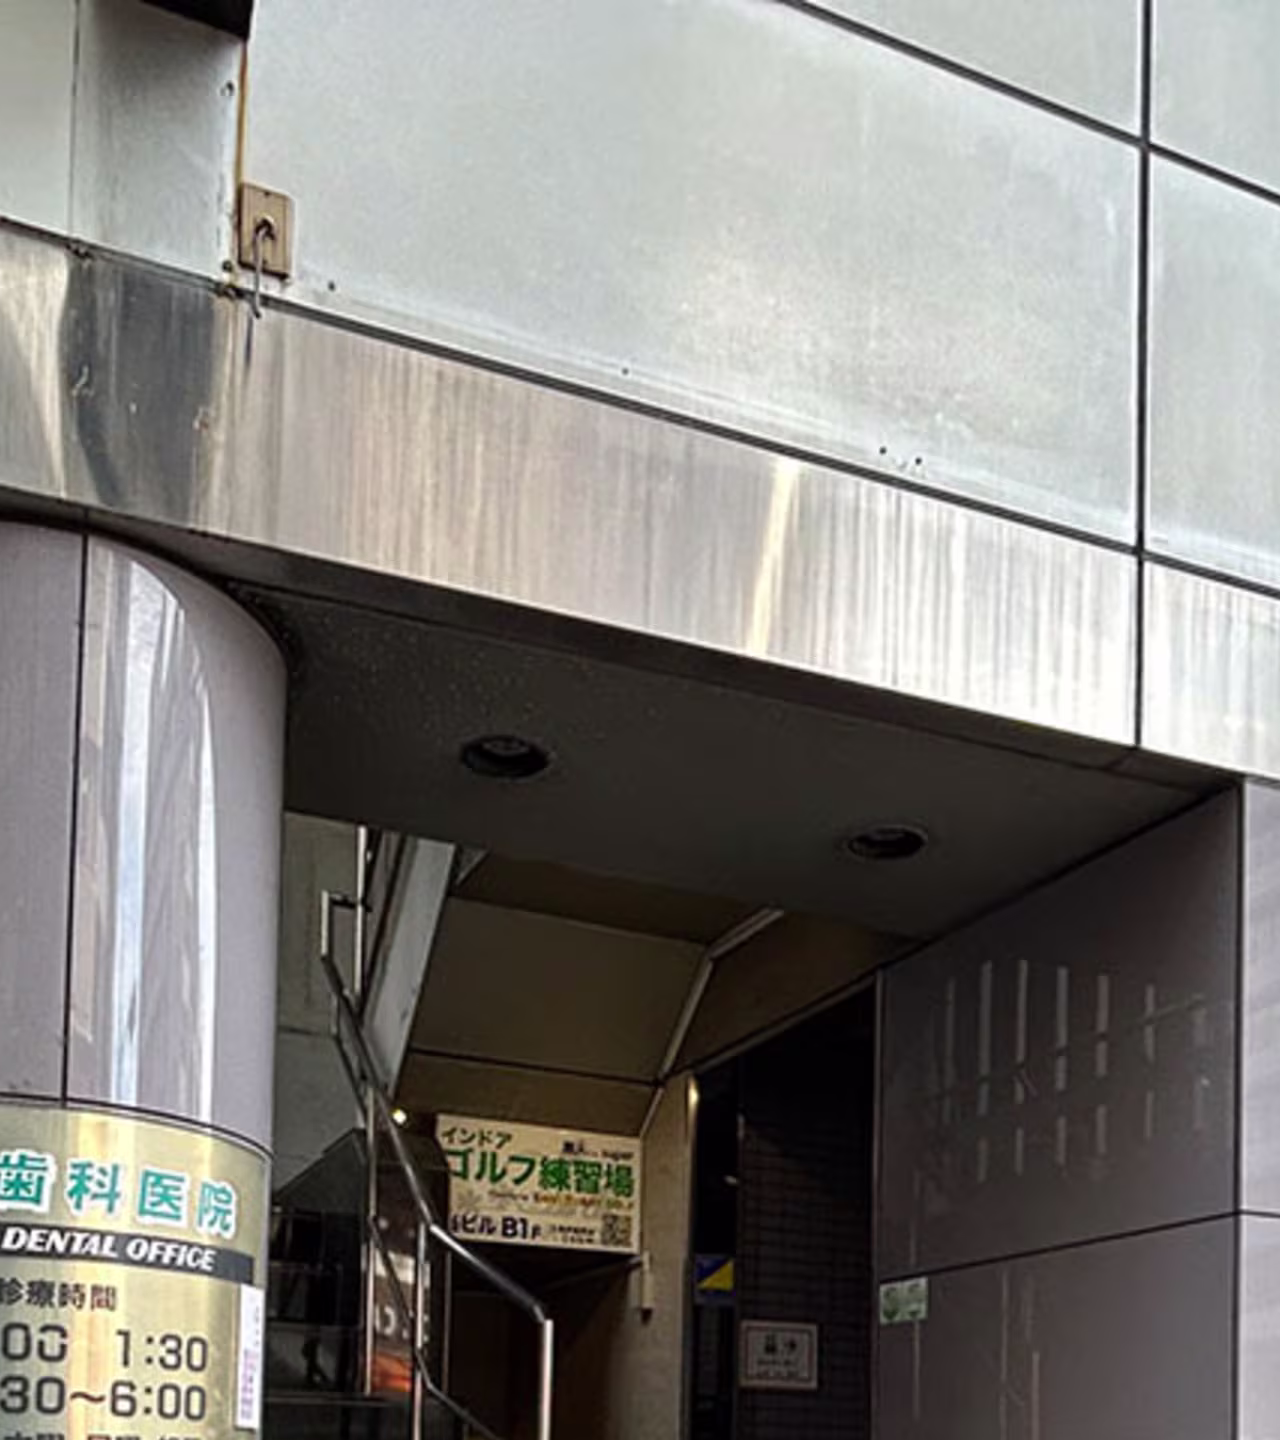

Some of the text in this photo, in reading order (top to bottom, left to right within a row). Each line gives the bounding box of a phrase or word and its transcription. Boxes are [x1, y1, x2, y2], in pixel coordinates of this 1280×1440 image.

[441, 1127, 512, 1149] インドア
[445, 1147, 636, 1198] ゴルフ練習場
[1, 1227, 120, 1259] DENTAL
[126, 1238, 216, 1272] OFFICE
[115, 1329, 208, 1373] 1:30
